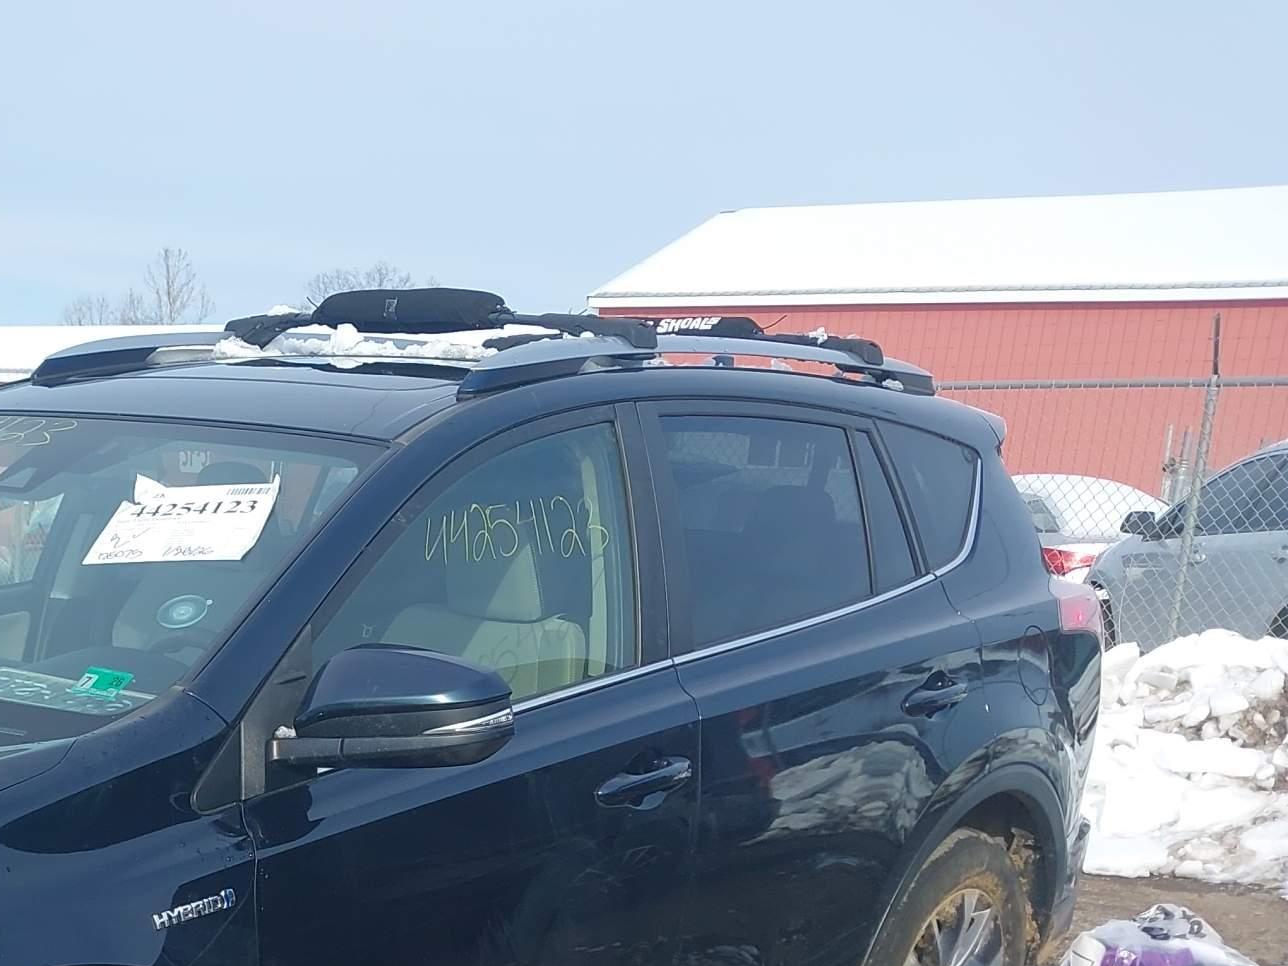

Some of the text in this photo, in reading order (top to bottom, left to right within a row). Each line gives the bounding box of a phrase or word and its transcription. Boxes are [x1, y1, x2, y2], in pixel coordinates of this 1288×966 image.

[656, 316, 722, 334] SHOALS
[130, 499, 259, 518] 44254123
[424, 496, 609, 565] 44254123
[80, 675, 92, 688] 7
[153, 895, 222, 930] HYBRID
